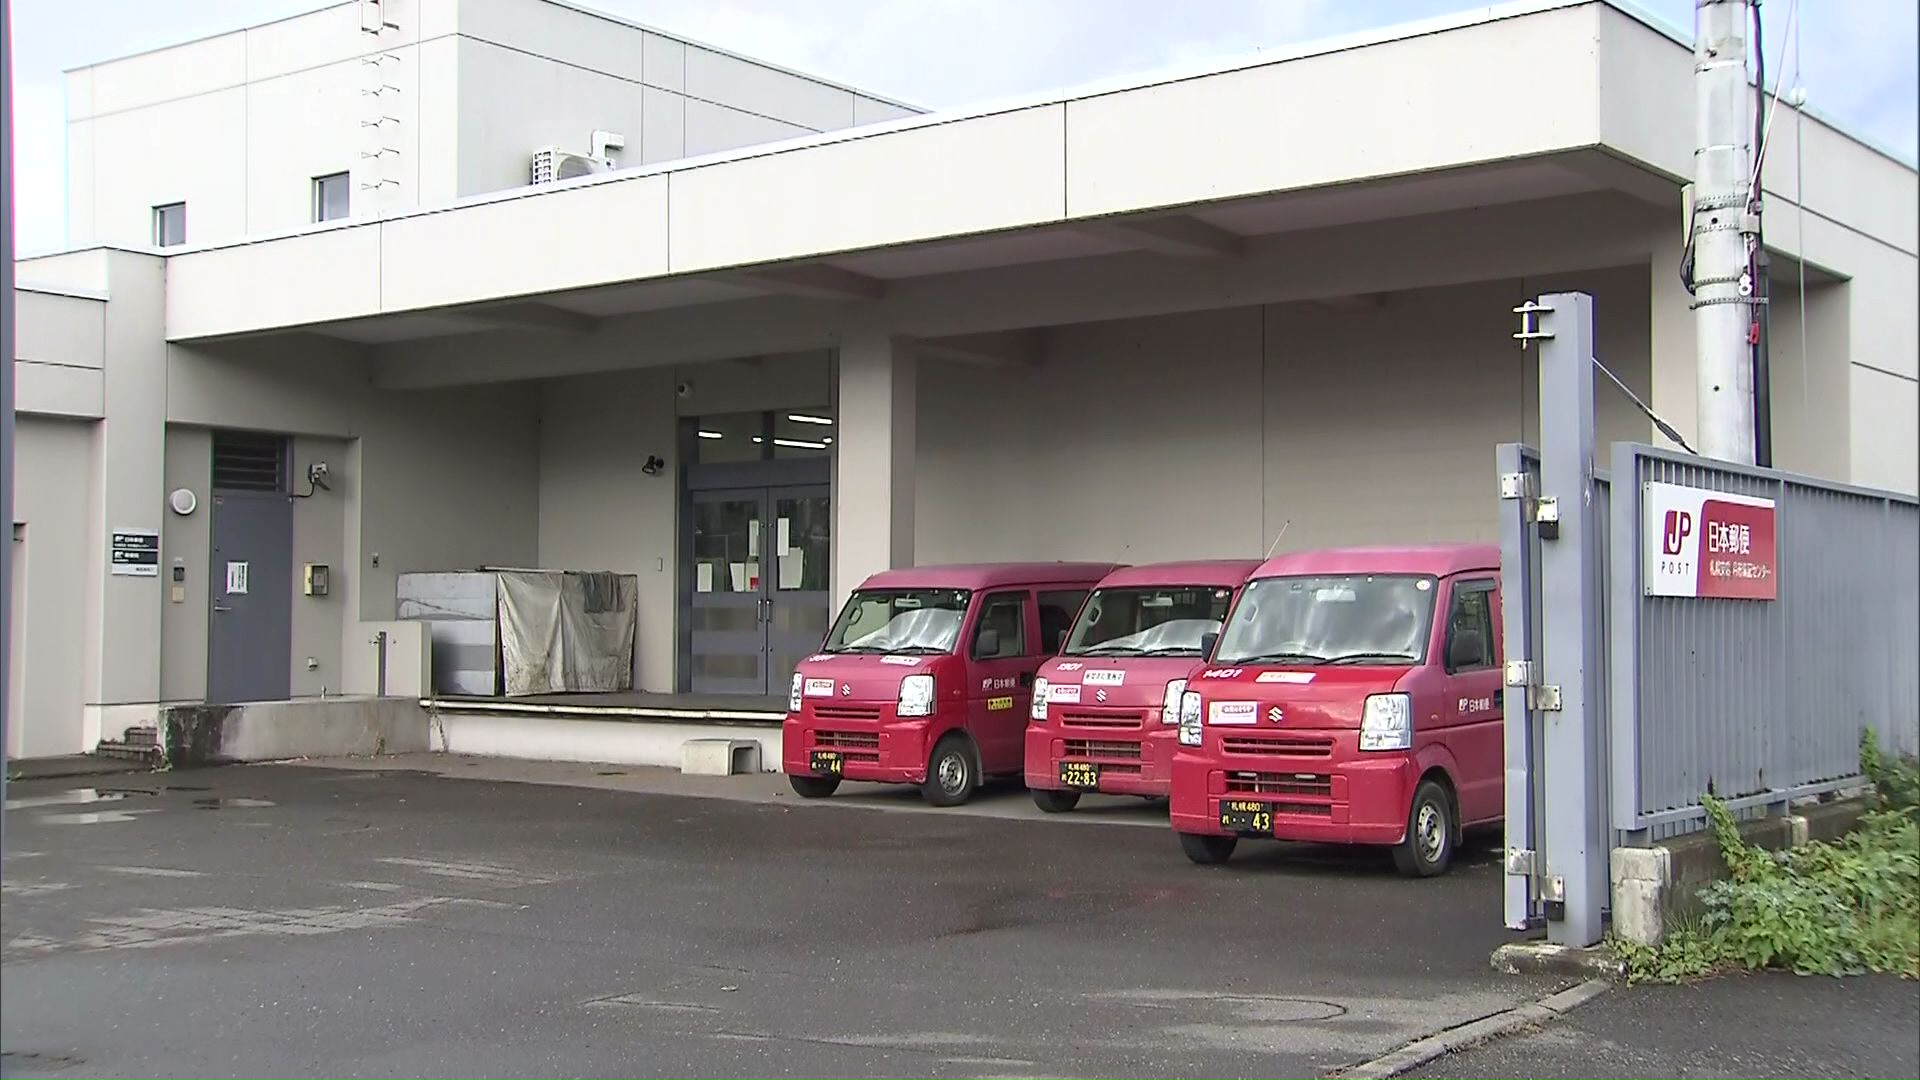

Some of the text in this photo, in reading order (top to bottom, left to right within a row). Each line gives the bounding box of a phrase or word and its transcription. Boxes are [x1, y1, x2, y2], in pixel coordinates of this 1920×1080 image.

[1663, 510, 1691, 555] JP
[1708, 521, 1750, 554] 日本郵便
[1661, 561, 1689, 575] POST
[1202, 669, 1243, 679] 1401
[830, 760, 841, 773] 44
[1231, 801, 1261, 812] 札幌480
